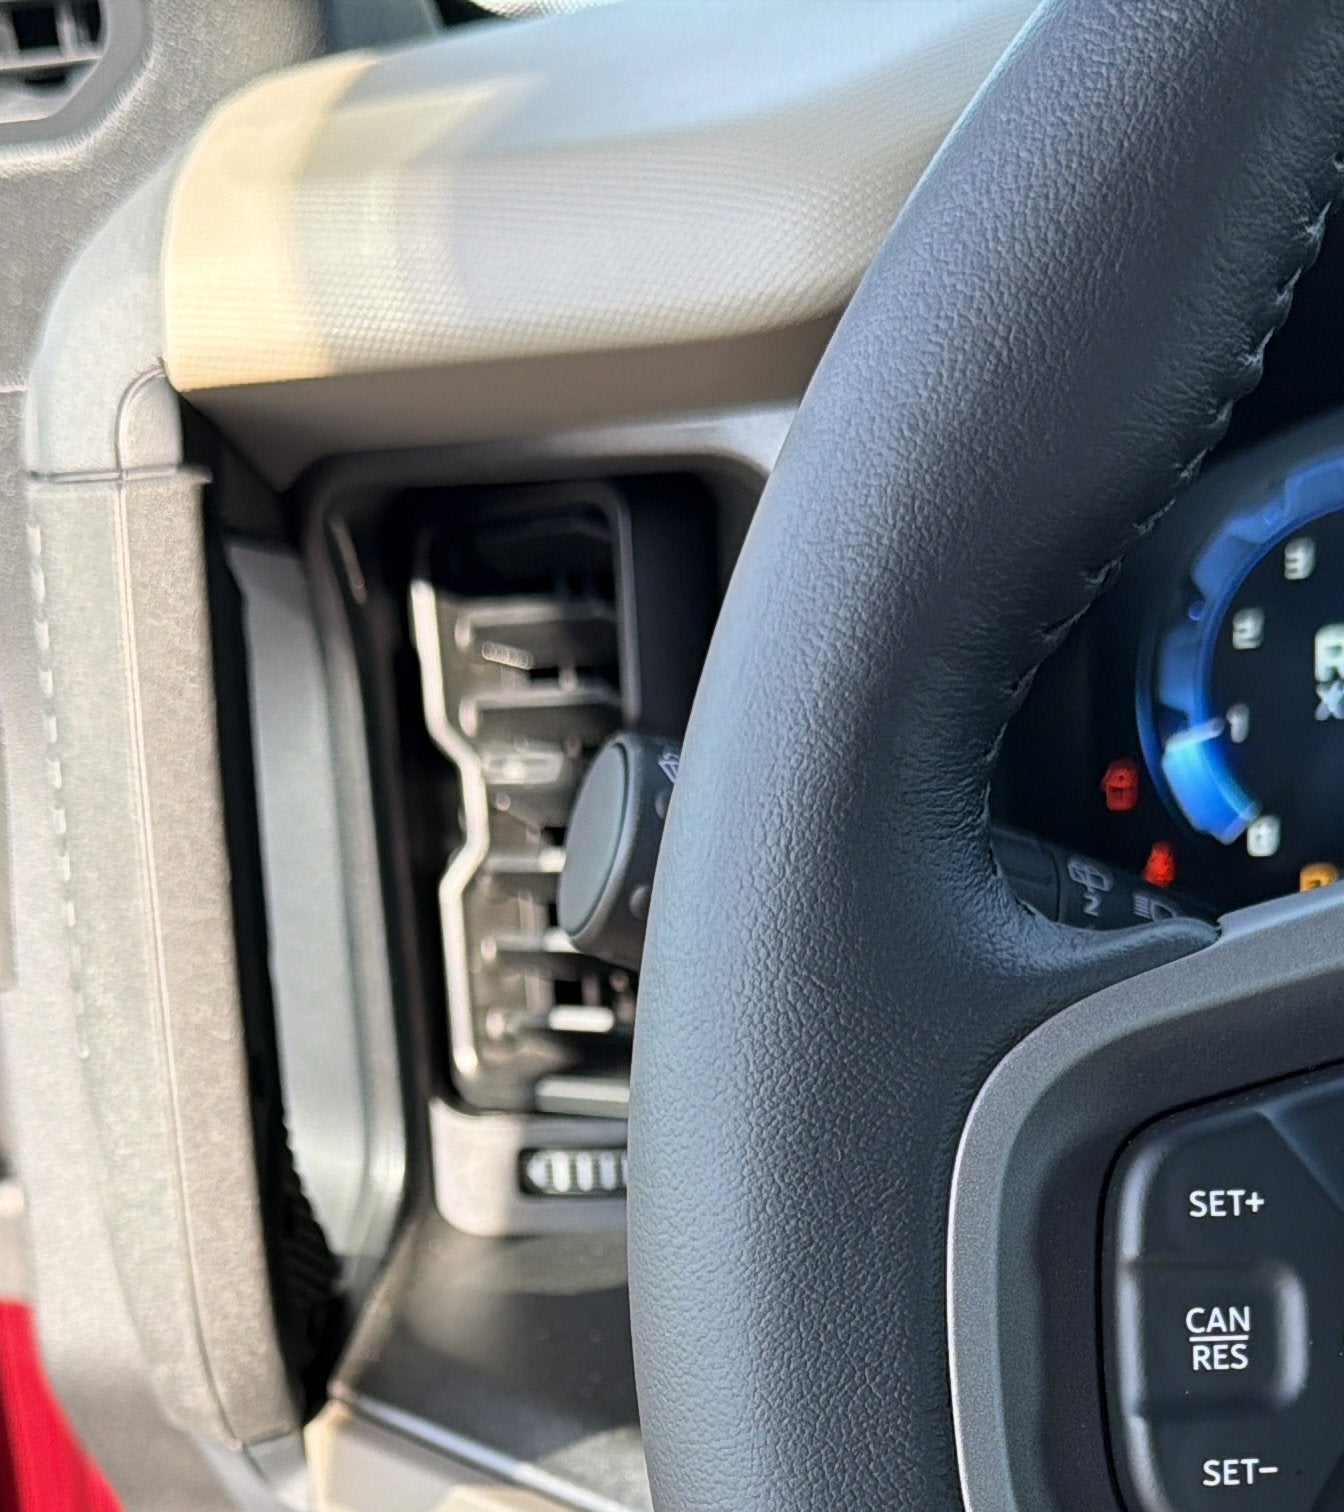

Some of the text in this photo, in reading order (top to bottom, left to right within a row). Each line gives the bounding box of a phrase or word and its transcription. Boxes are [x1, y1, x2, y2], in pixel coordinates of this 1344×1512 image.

[1189, 1190, 1265, 1217] SET+
[1185, 1307, 1250, 1333] CAN
[1191, 1344, 1249, 1371] RES
[1202, 1458, 1278, 1486] SET-
